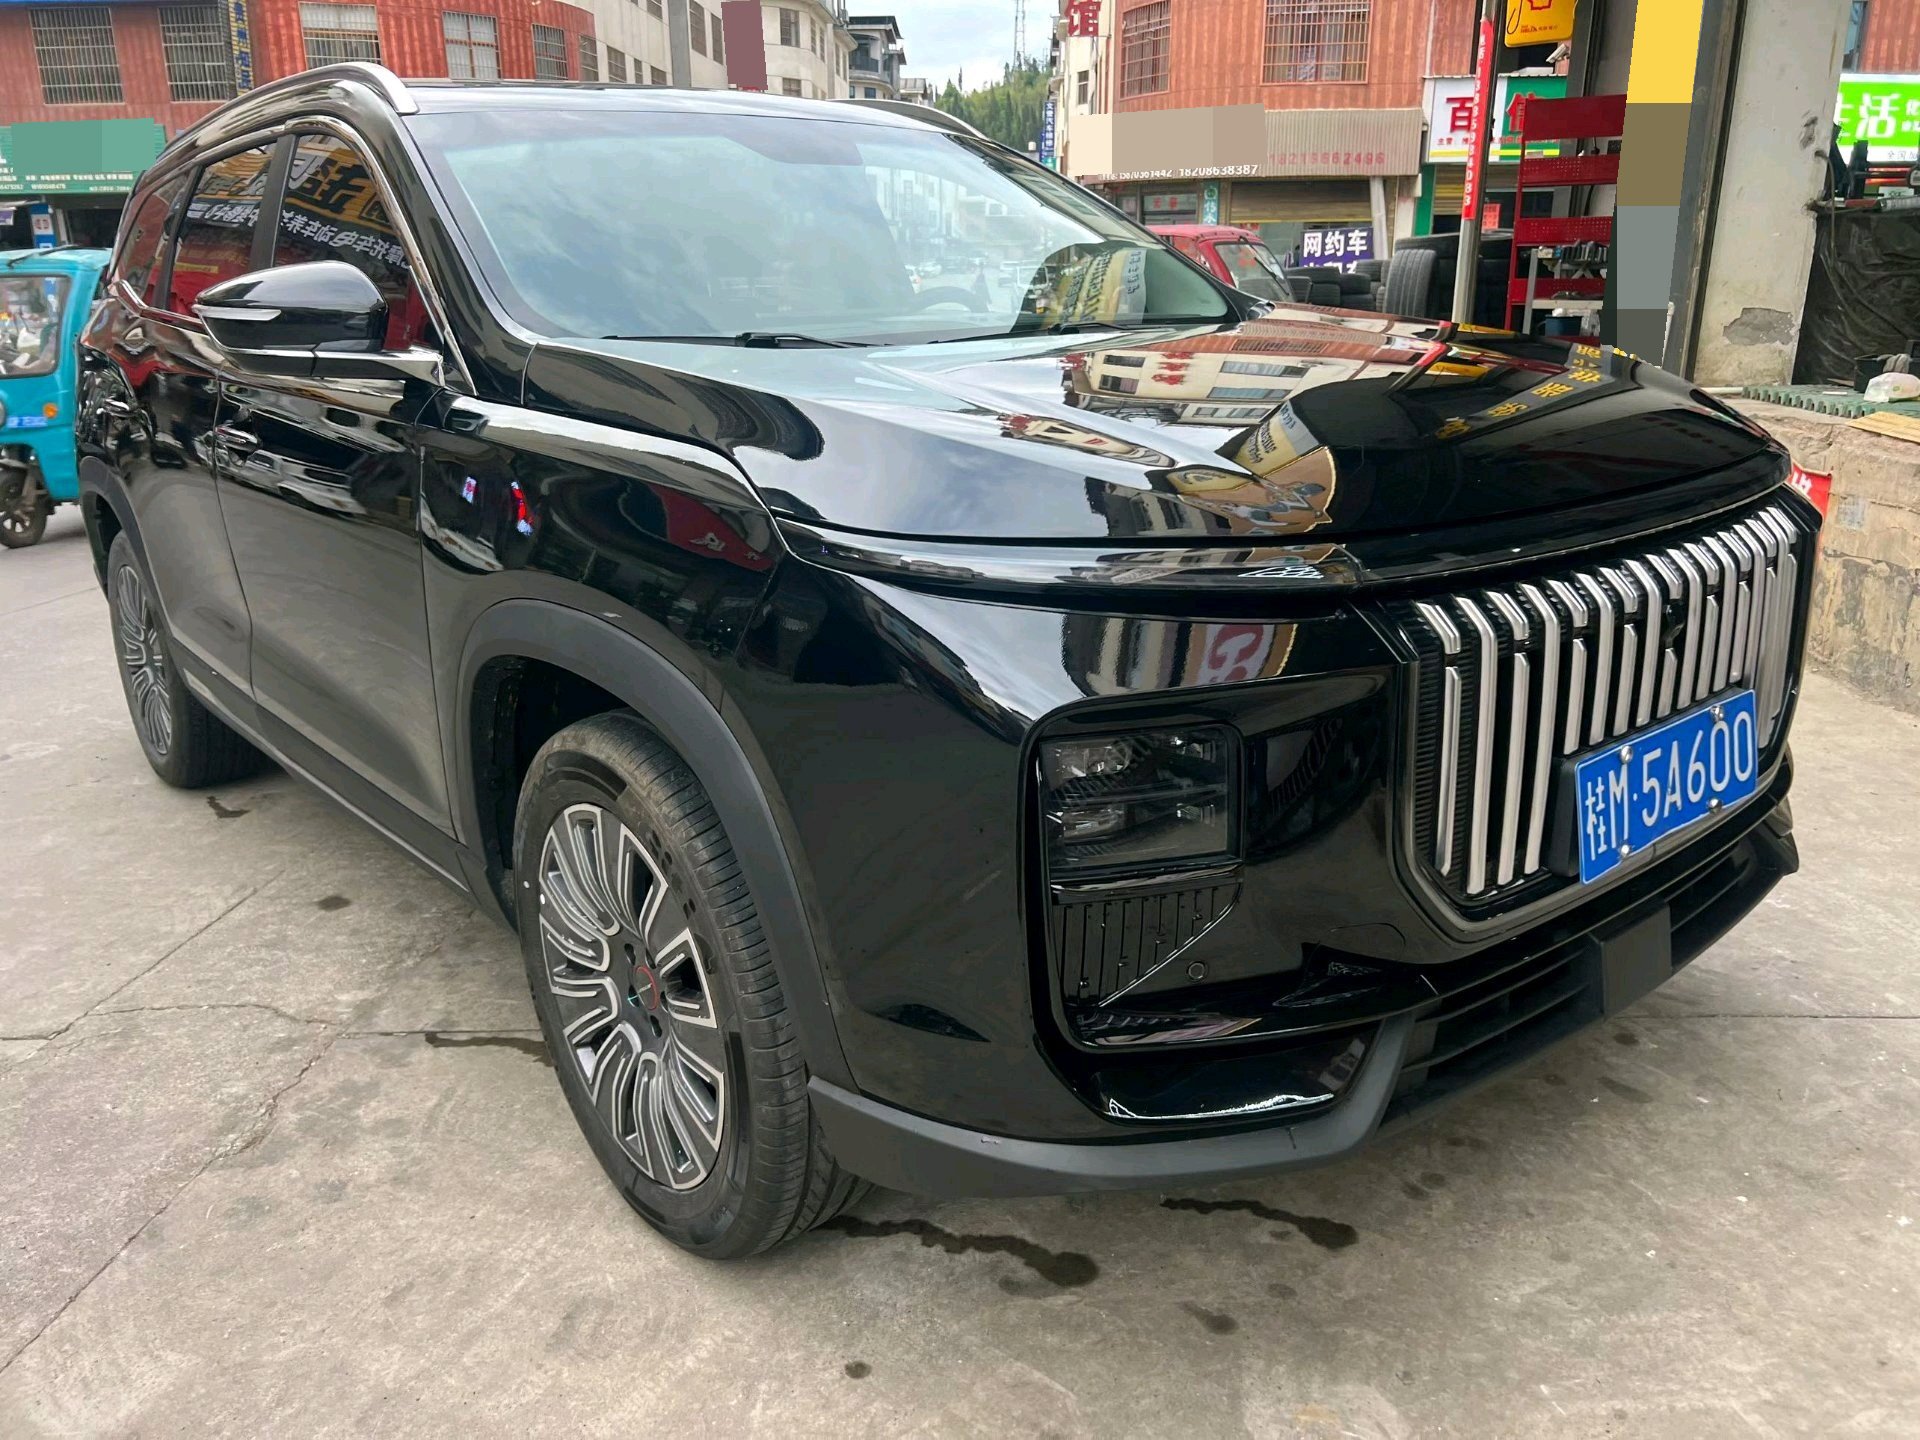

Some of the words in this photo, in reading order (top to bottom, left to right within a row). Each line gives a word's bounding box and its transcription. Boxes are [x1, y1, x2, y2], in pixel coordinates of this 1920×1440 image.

[1065, 0, 1101, 37] 馆
[1303, 230, 1368, 258] 网约车
